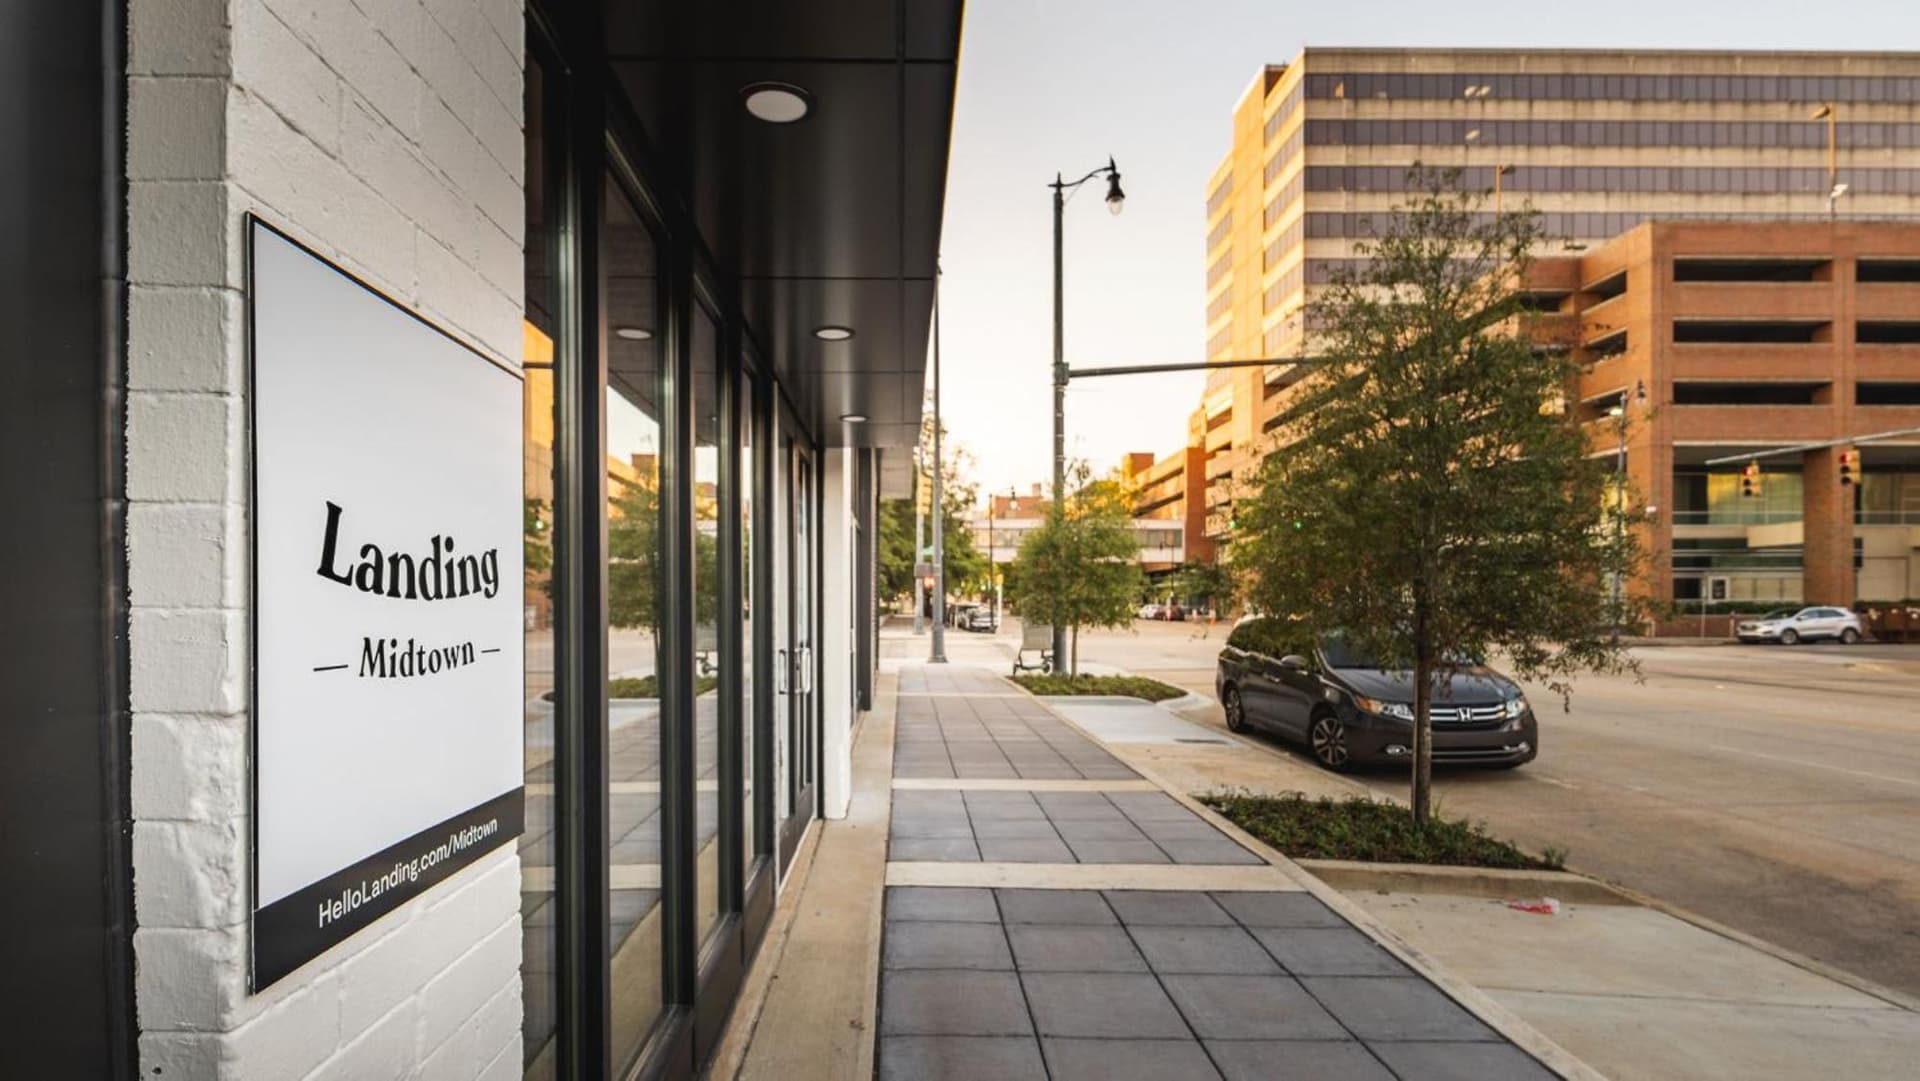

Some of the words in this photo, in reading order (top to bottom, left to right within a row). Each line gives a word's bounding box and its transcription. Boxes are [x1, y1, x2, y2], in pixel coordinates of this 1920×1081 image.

[317, 500, 499, 601] Landing
[359, 637, 475, 678] Midtown
[319, 818, 498, 928] HelloLanding.com/Midtown
